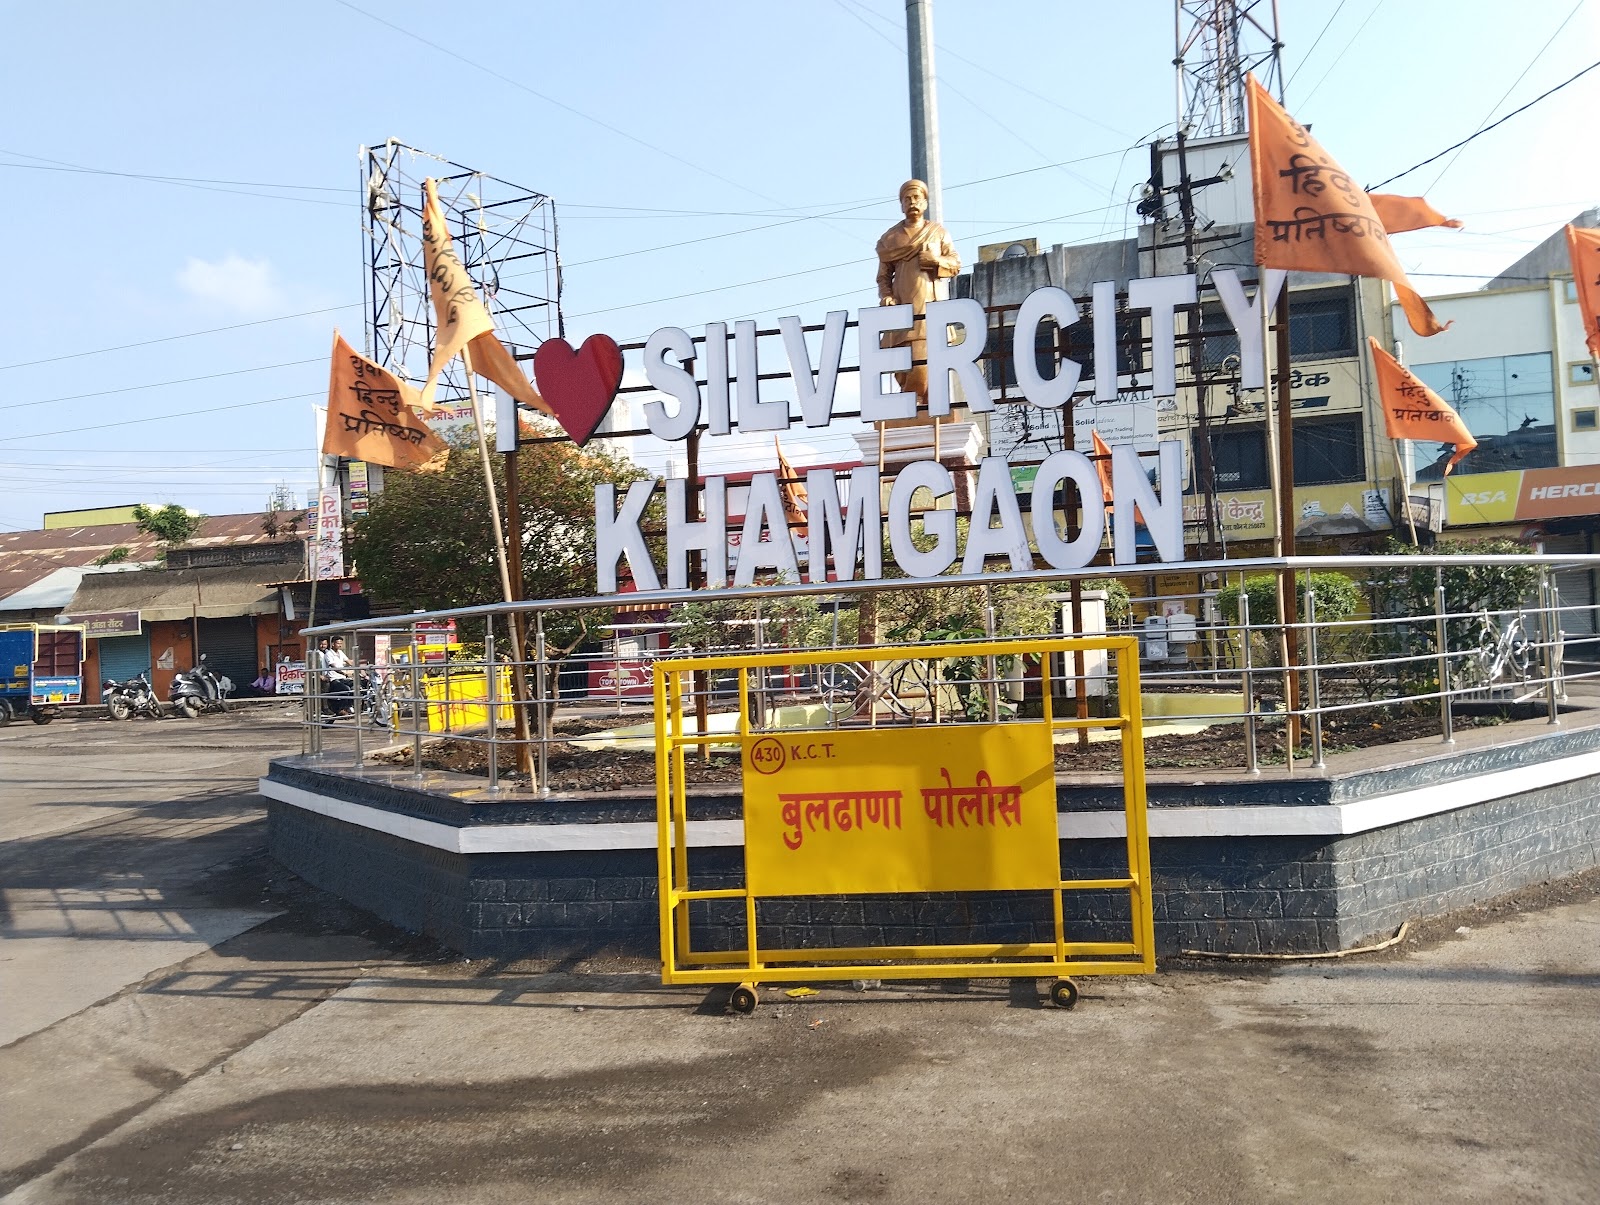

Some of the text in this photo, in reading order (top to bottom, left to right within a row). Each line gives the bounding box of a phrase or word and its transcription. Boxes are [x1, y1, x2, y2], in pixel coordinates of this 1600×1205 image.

[643, 298, 997, 442] SILVER
[1013, 268, 1289, 409] CITY
[1075, 418, 1095, 426] Solid
[1228, 497, 1265, 522] केन्द्र
[1460, 490, 1507, 506] BSA
[594, 439, 1185, 593] KHAMGAON
[754, 746, 781, 762] 430
[778, 767, 1023, 851] बुलढाणा पोलीस
